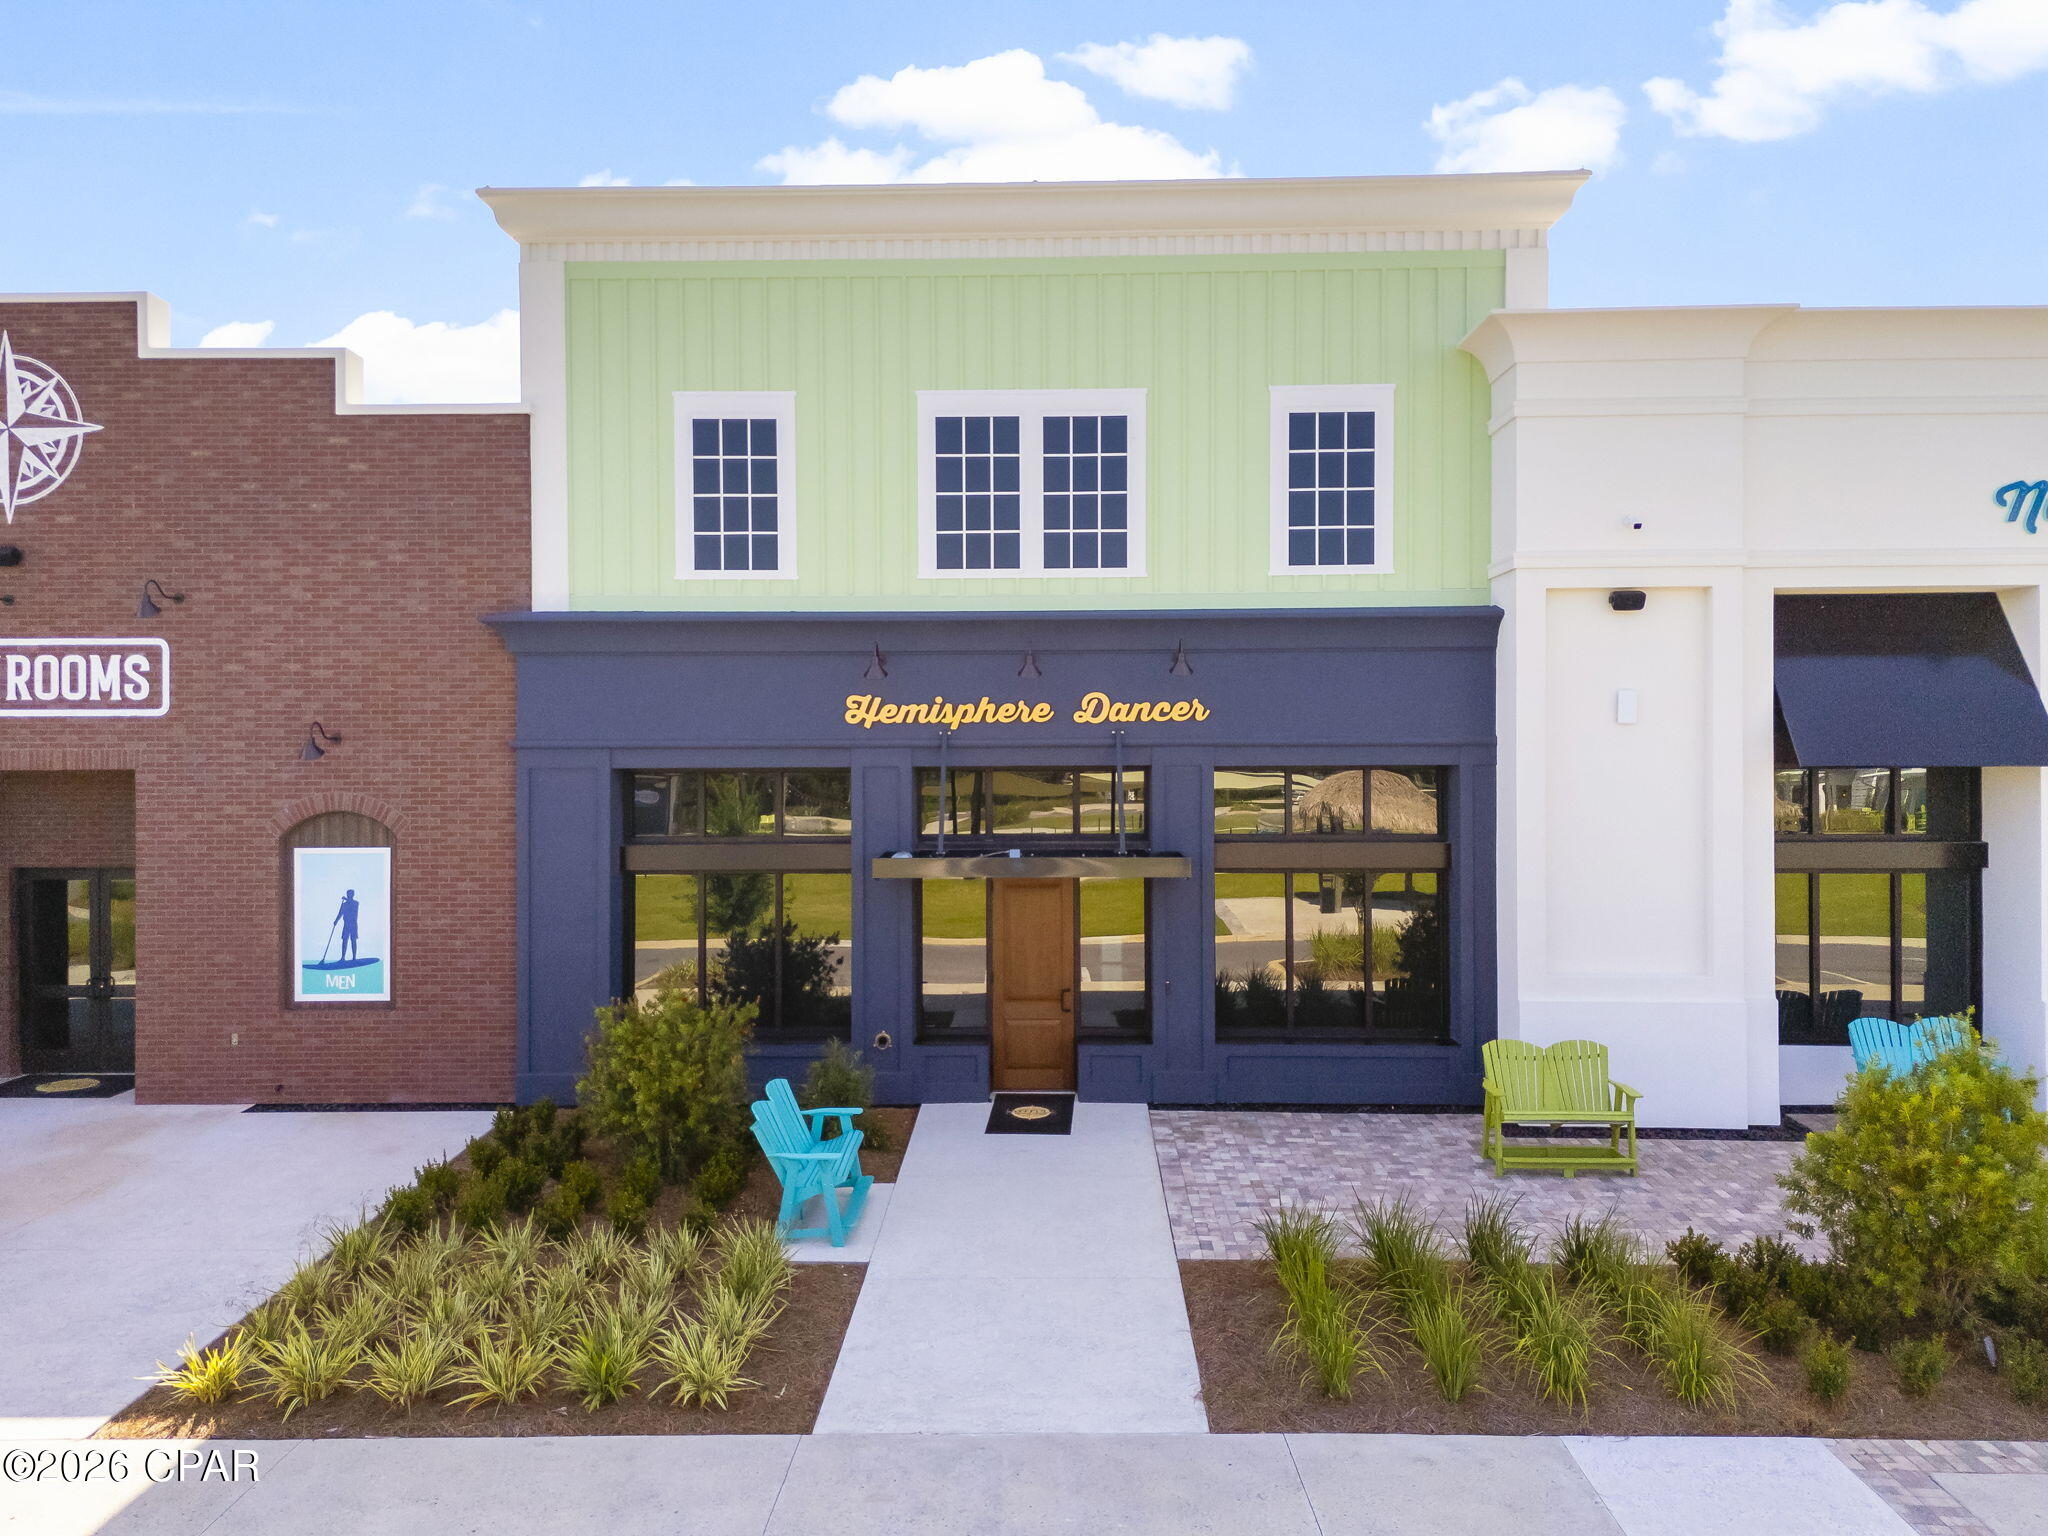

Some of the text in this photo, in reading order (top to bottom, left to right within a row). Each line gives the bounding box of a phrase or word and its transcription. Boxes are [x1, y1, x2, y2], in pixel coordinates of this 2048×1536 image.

[5, 654, 150, 701] ROOMS
[845, 692, 1210, 730] Hemisphere Dancer
[325, 973, 356, 990] MEN
